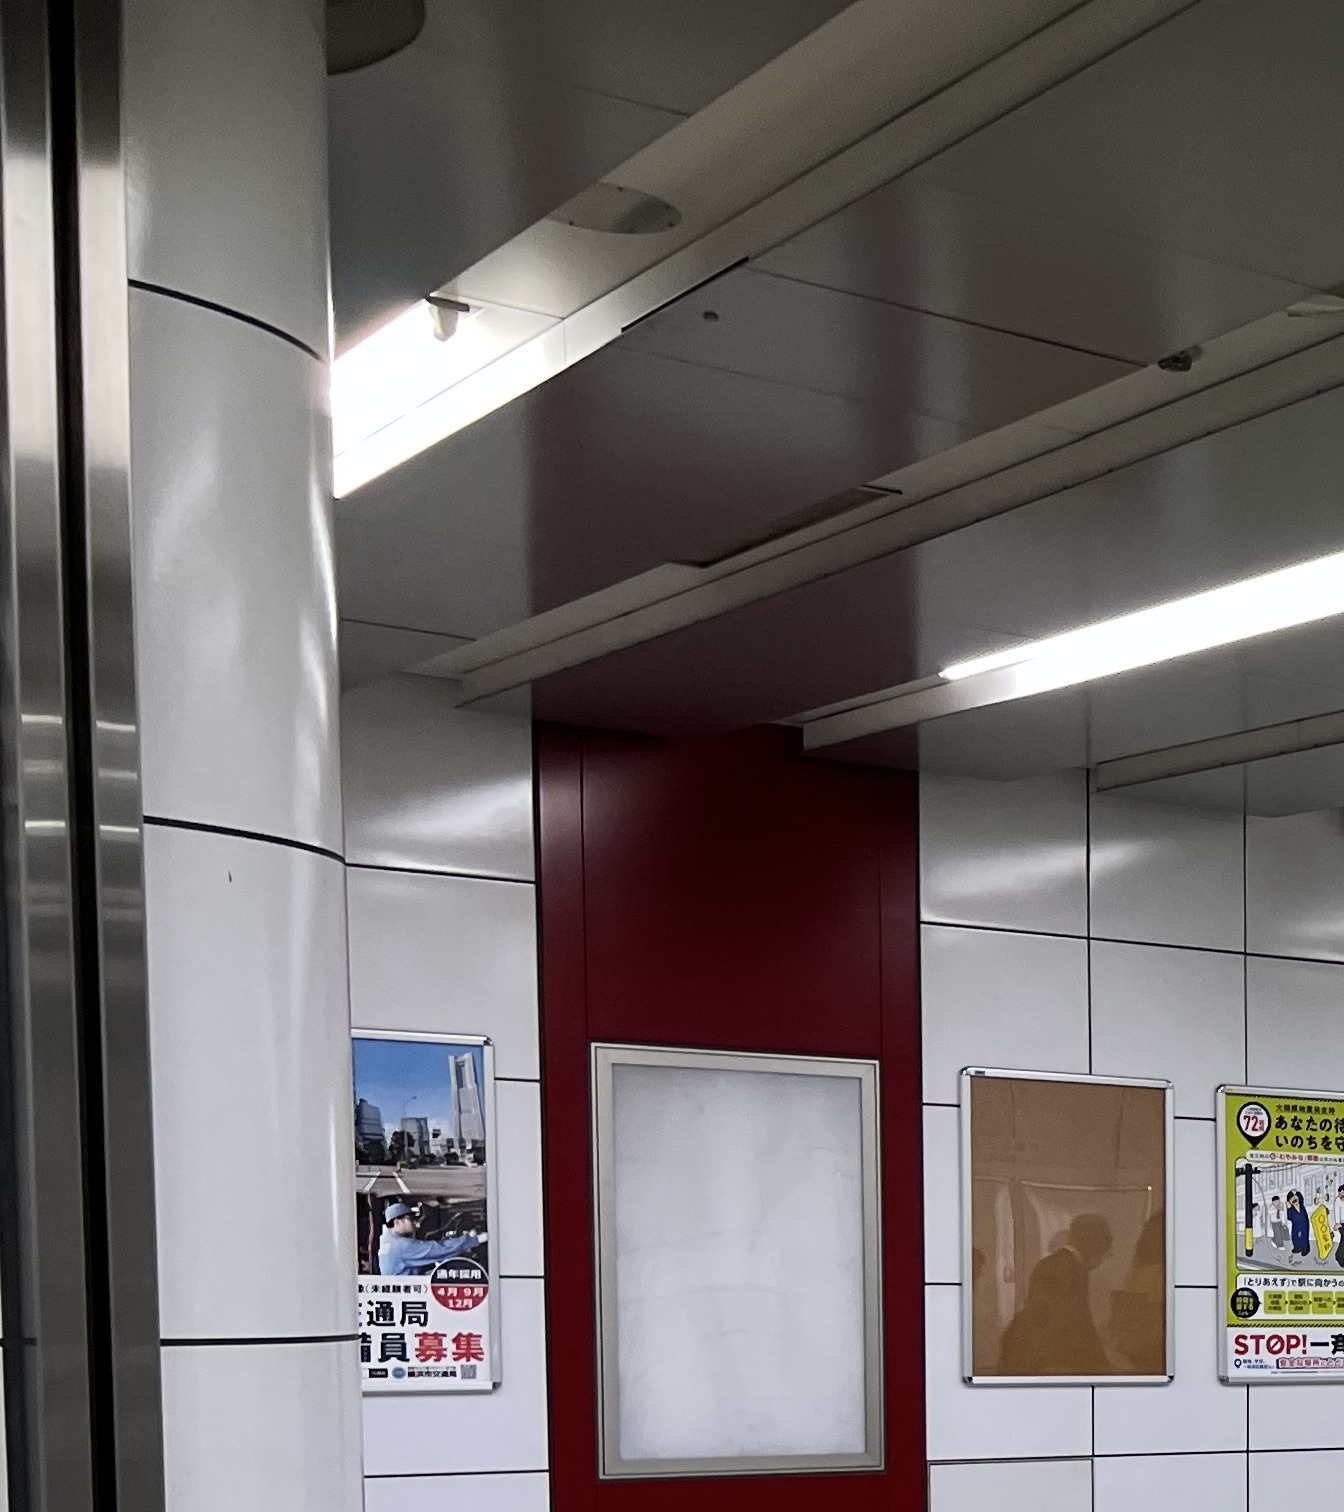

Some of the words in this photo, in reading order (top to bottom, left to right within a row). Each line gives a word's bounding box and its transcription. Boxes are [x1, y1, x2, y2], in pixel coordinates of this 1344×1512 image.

[437, 1287, 458, 1297] 4月
[463, 1287, 484, 1297] 9月
[448, 1299, 473, 1309] 12月
[358, 1300, 429, 1328] 通局
